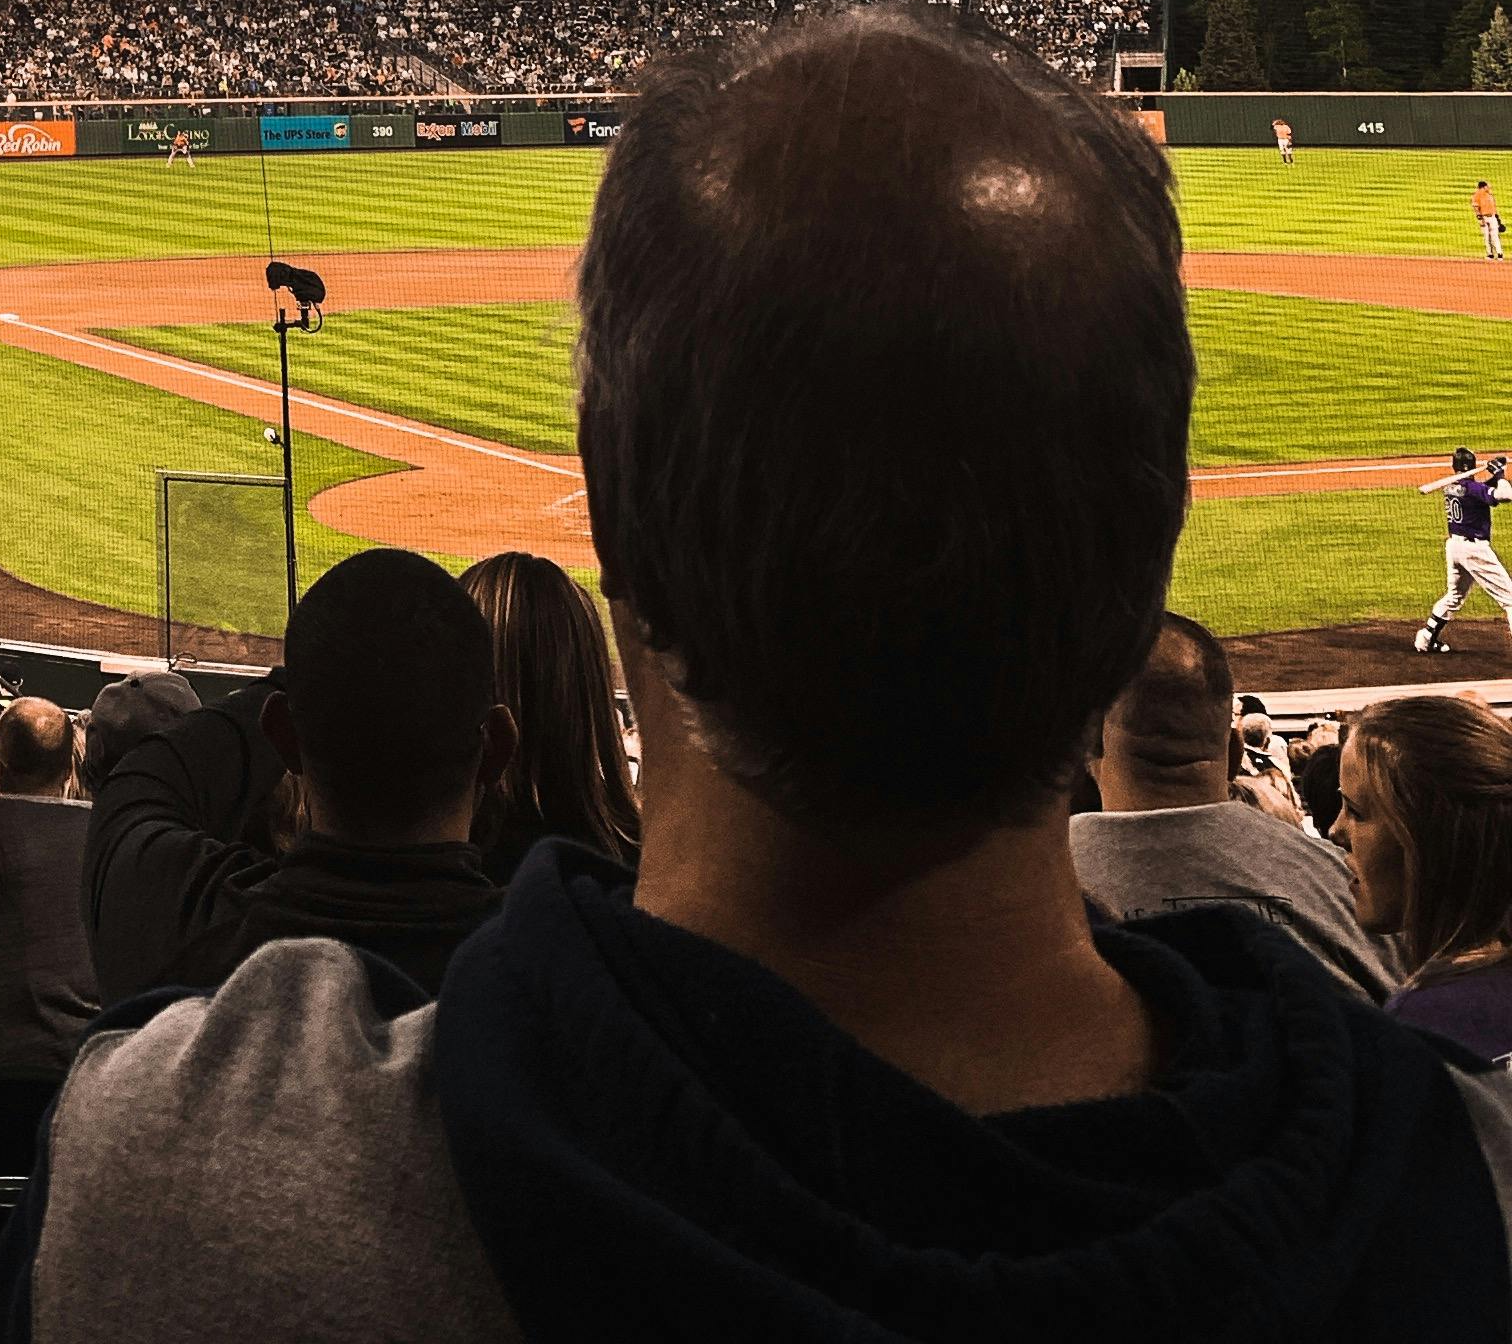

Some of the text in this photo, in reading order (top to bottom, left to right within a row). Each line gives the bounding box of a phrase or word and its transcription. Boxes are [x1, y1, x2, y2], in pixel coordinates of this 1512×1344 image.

[372, 126, 393, 138] 390
[416, 122, 498, 141] Exxon Mobil
[1357, 122, 1385, 134] 415
[263, 129, 331, 141] The UPS Store
[21, 133, 62, 153] Robin
